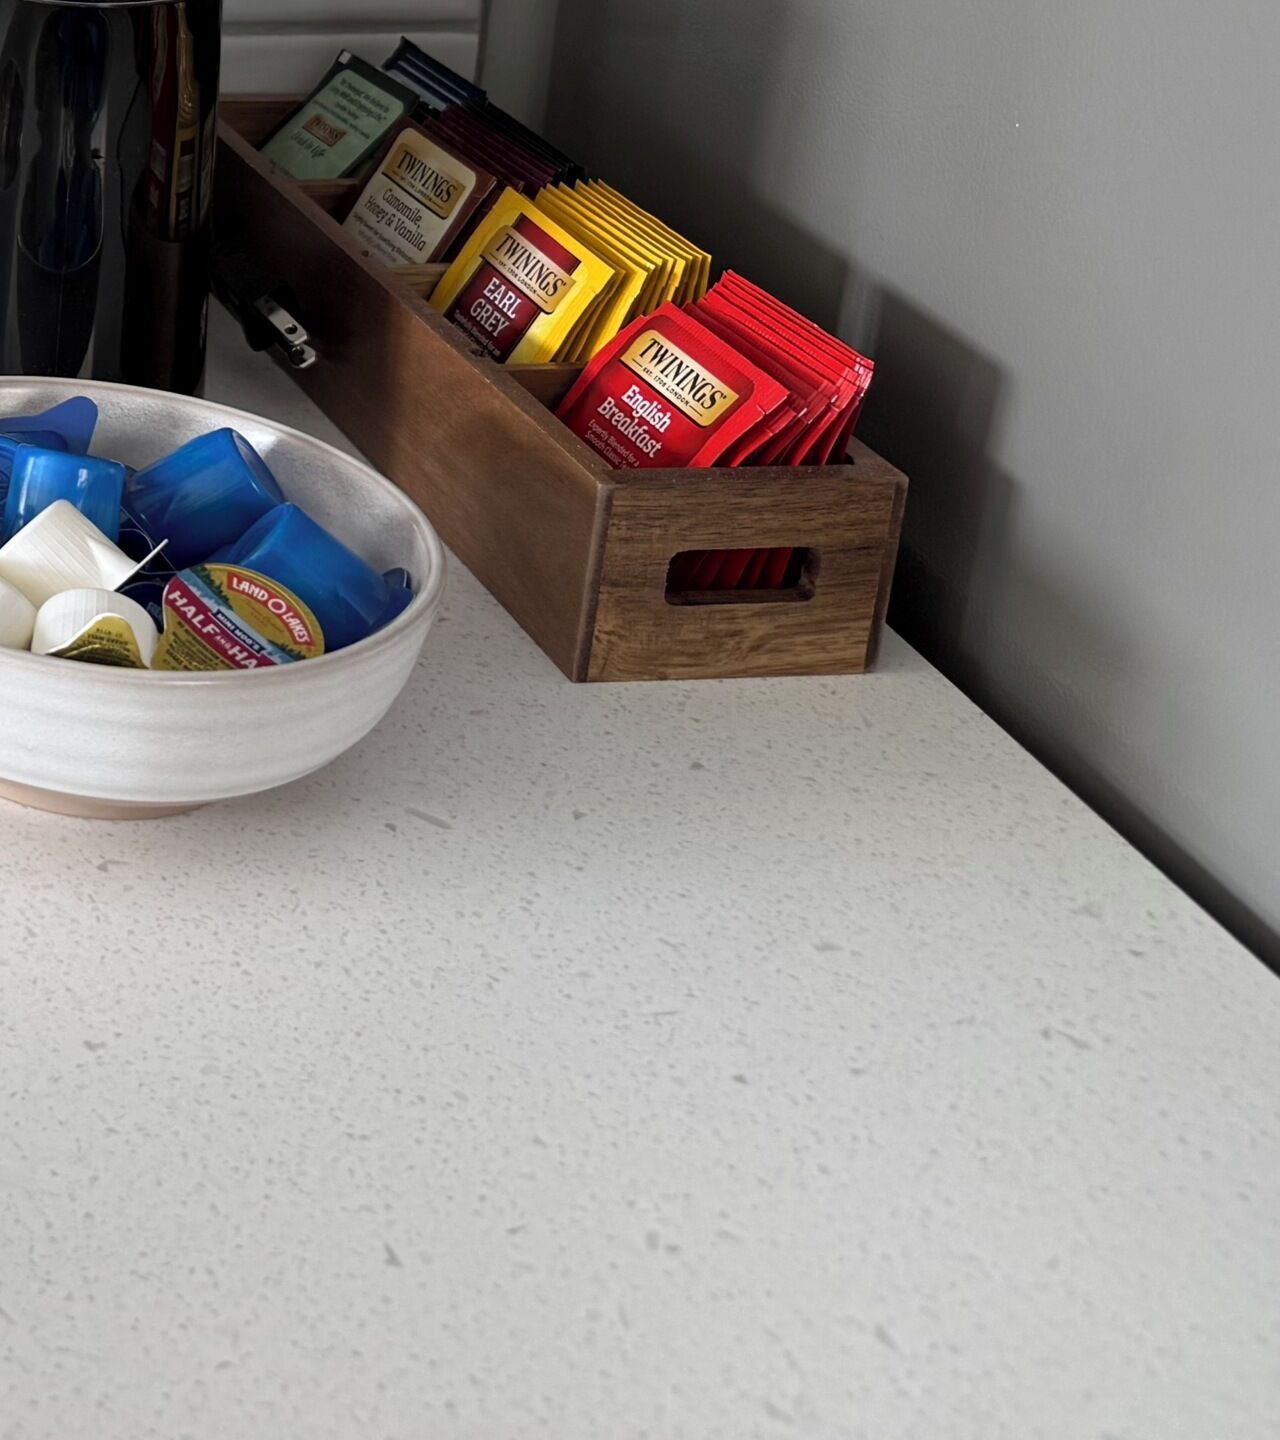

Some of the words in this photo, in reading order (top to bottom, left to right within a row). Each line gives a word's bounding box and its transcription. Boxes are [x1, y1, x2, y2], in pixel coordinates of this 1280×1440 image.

[397, 150, 456, 203] TWININGS
[364, 195, 388, 224] Honey
[385, 213, 397, 227] &
[393, 218, 427, 252] Vanilla
[382, 188, 423, 228] Camomile,
[496, 233, 566, 297] TWININGS
[518, 276, 538, 295] LONDON
[470, 298, 511, 337] GREY
[483, 277, 522, 319] EARL
[639, 337, 726, 410] TWININGS
[665, 385, 690, 407] LONDON
[597, 396, 663, 459] Breakfast
[621, 384, 672, 433] English
[168, 590, 219, 637] HALF
[227, 645, 258, 669] HA
[216, 613, 235, 631] MINI
[234, 628, 261, 651] MOO'S
[232, 576, 269, 601] LAND
[267, 598, 287, 614] O
[283, 612, 311, 643] LAKES
